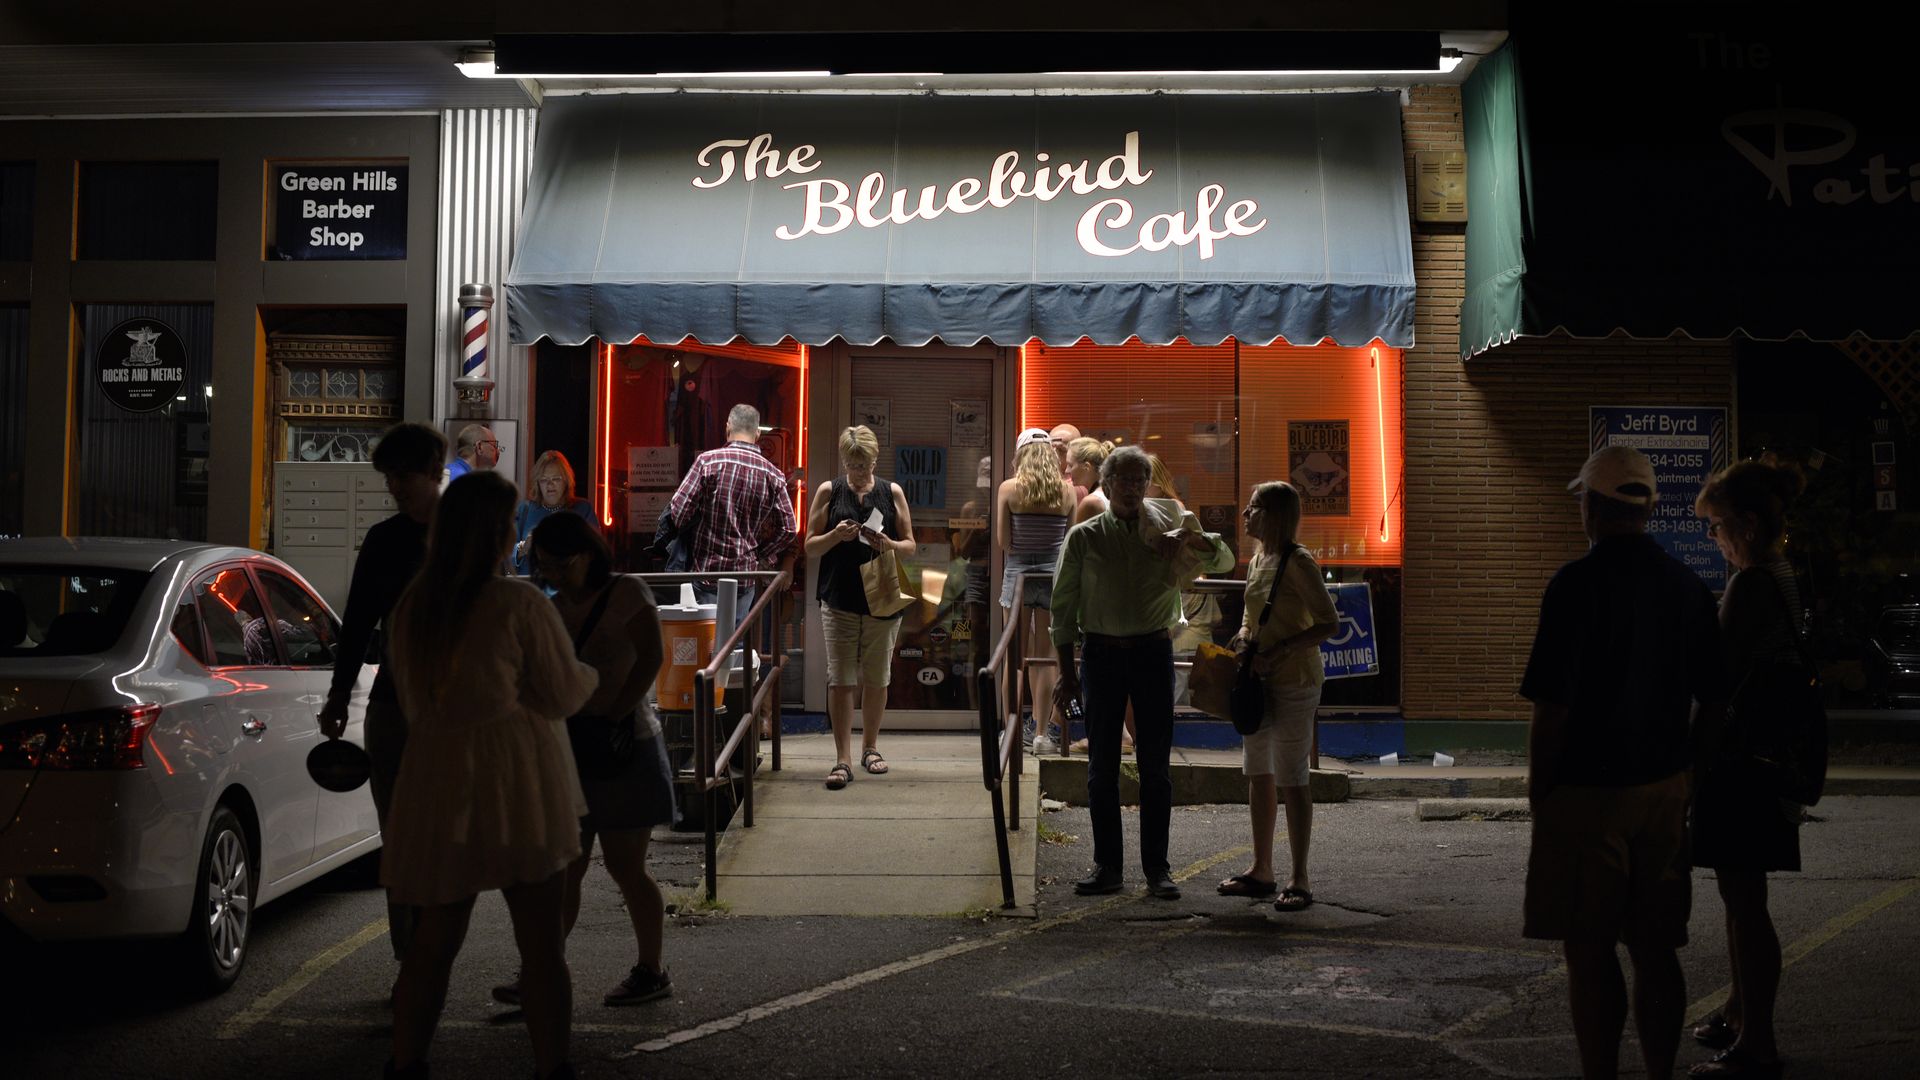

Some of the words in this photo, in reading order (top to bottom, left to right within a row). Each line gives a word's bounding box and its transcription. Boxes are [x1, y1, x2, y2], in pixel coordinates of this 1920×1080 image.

[1688, 31, 1773, 70] The
[691, 133, 822, 190] The
[281, 171, 346, 192] Green
[352, 171, 398, 192] Hills
[775, 131, 1154, 241] Bluebird
[302, 198, 375, 219] Barber
[1076, 184, 1268, 261] Cafe
[309, 226, 365, 251] Shop
[102, 368, 129, 383] ROCKS
[131, 368, 148, 382] AND
[150, 367, 183, 382] METALS
[1620, 414, 1656, 432] Jeff
[1659, 414, 1697, 435] Byrd
[1289, 429, 1347, 446] BLUEBIRD
[1610, 436, 1645, 448] Barber
[899, 448, 943, 476] SOLD
[904, 479, 938, 505] OUT
[1661, 504, 1685, 517] Hair
[1672, 540, 1695, 552] Thru
[1683, 553, 1711, 565] Salon
[1321, 646, 1373, 668] PARKING
[922, 671, 939, 681] FA
